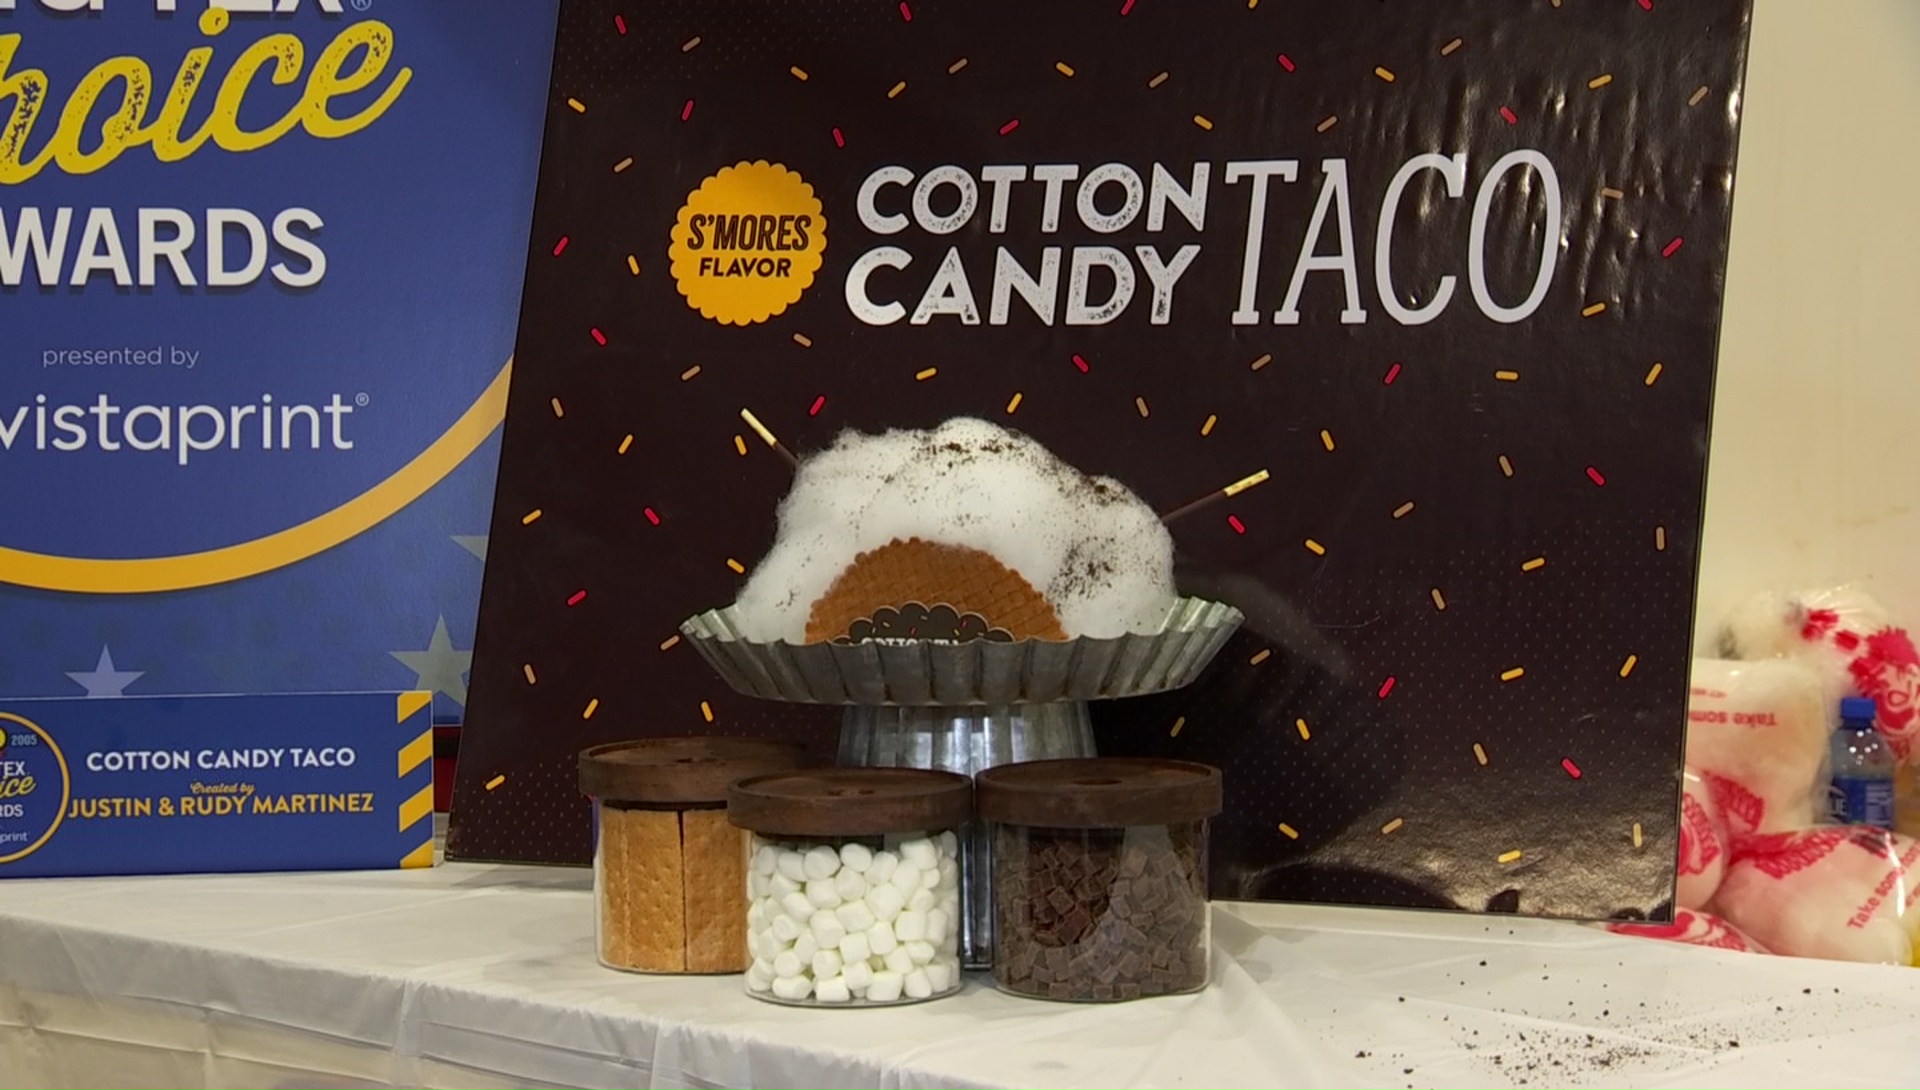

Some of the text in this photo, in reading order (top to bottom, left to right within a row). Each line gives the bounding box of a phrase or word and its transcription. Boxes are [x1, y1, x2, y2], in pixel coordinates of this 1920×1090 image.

[856, 162, 1211, 235] COTTON
[687, 214, 812, 251] S'MORES
[1225, 149, 1561, 325] TACO
[699, 257, 792, 278] FLAVOR
[845, 245, 1201, 326] CANDY
[43, 345, 200, 367] presented by
[11, 734, 38, 746] 2005
[86, 747, 356, 771] COTTON CANDY TACO
[190, 781, 256, 796] Created by
[68, 793, 374, 818] JUSTIN & RUDY MARTINEZ
[1847, 897, 1880, 929] Take
